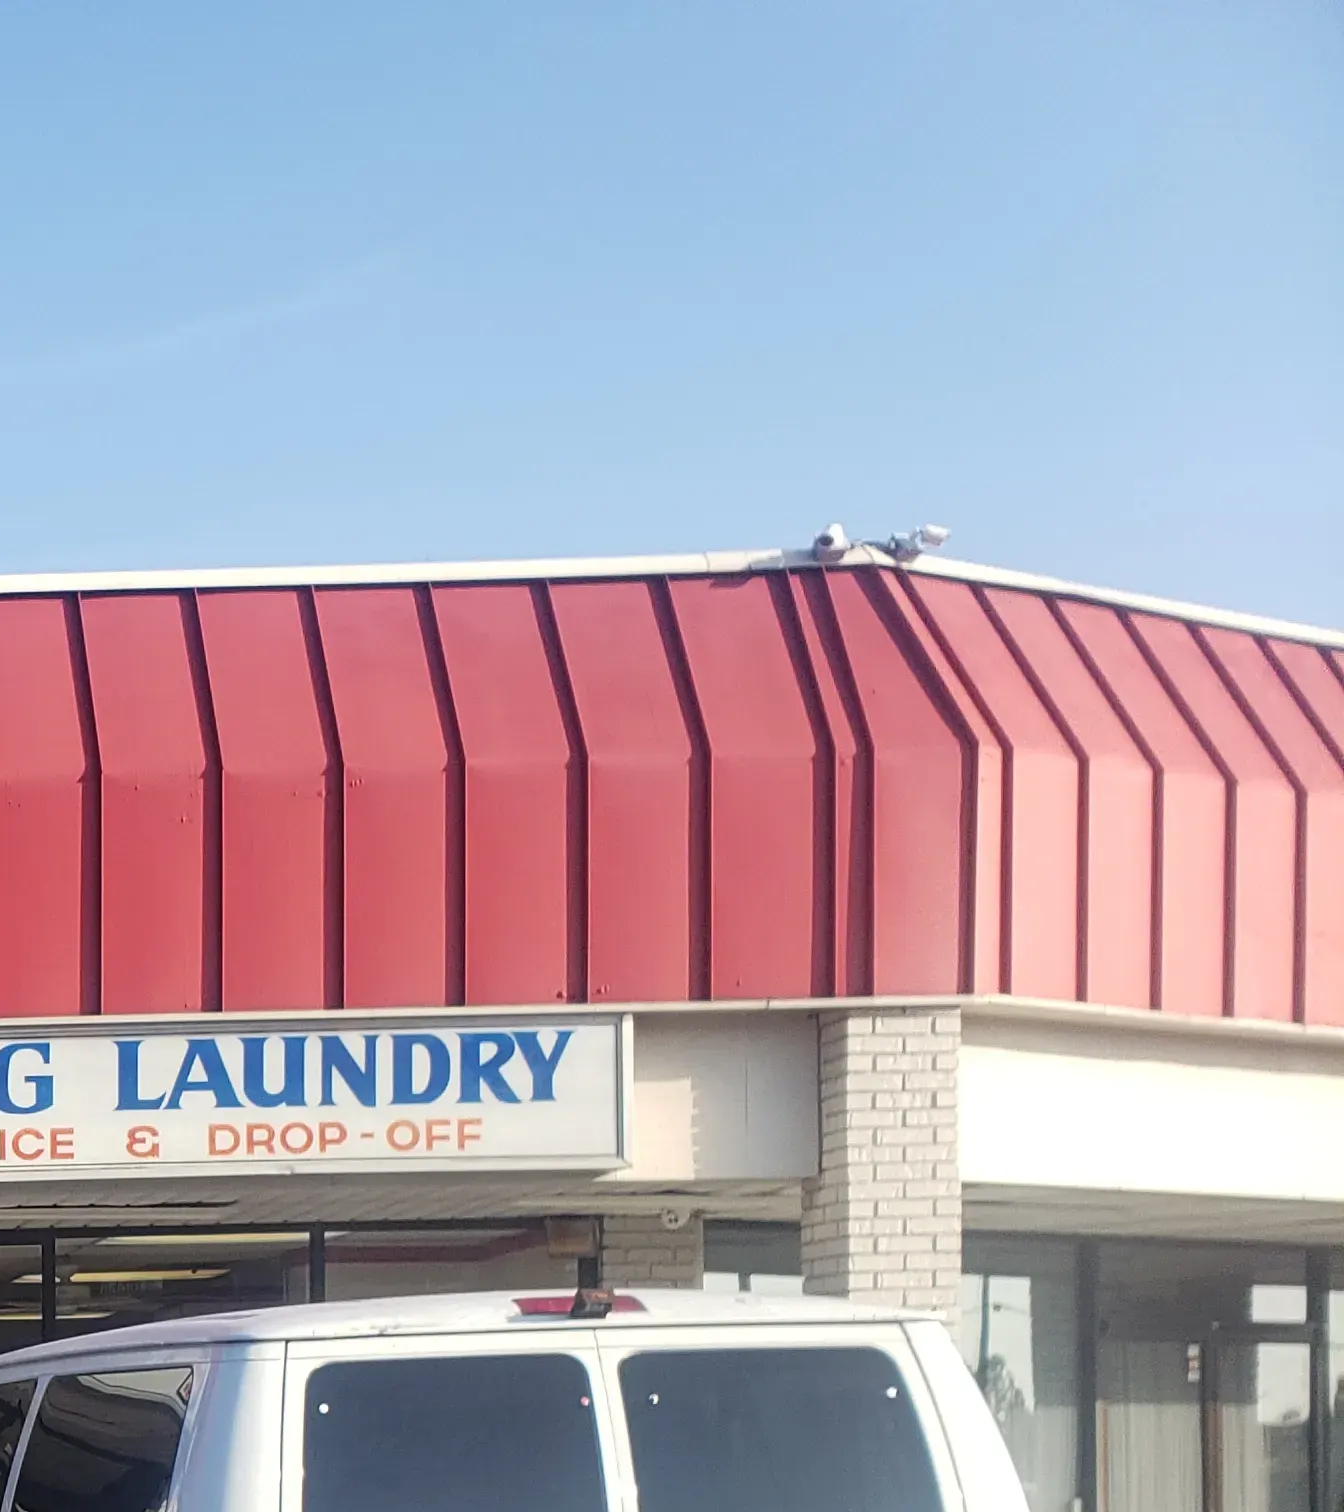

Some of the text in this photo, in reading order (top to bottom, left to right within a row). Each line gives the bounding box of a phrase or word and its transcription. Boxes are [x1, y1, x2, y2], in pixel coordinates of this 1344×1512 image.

[113, 1030, 575, 1111] LAUNDRY
[125, 1125, 161, 1158] &
[207, 1118, 483, 1156] DROP-OFF
